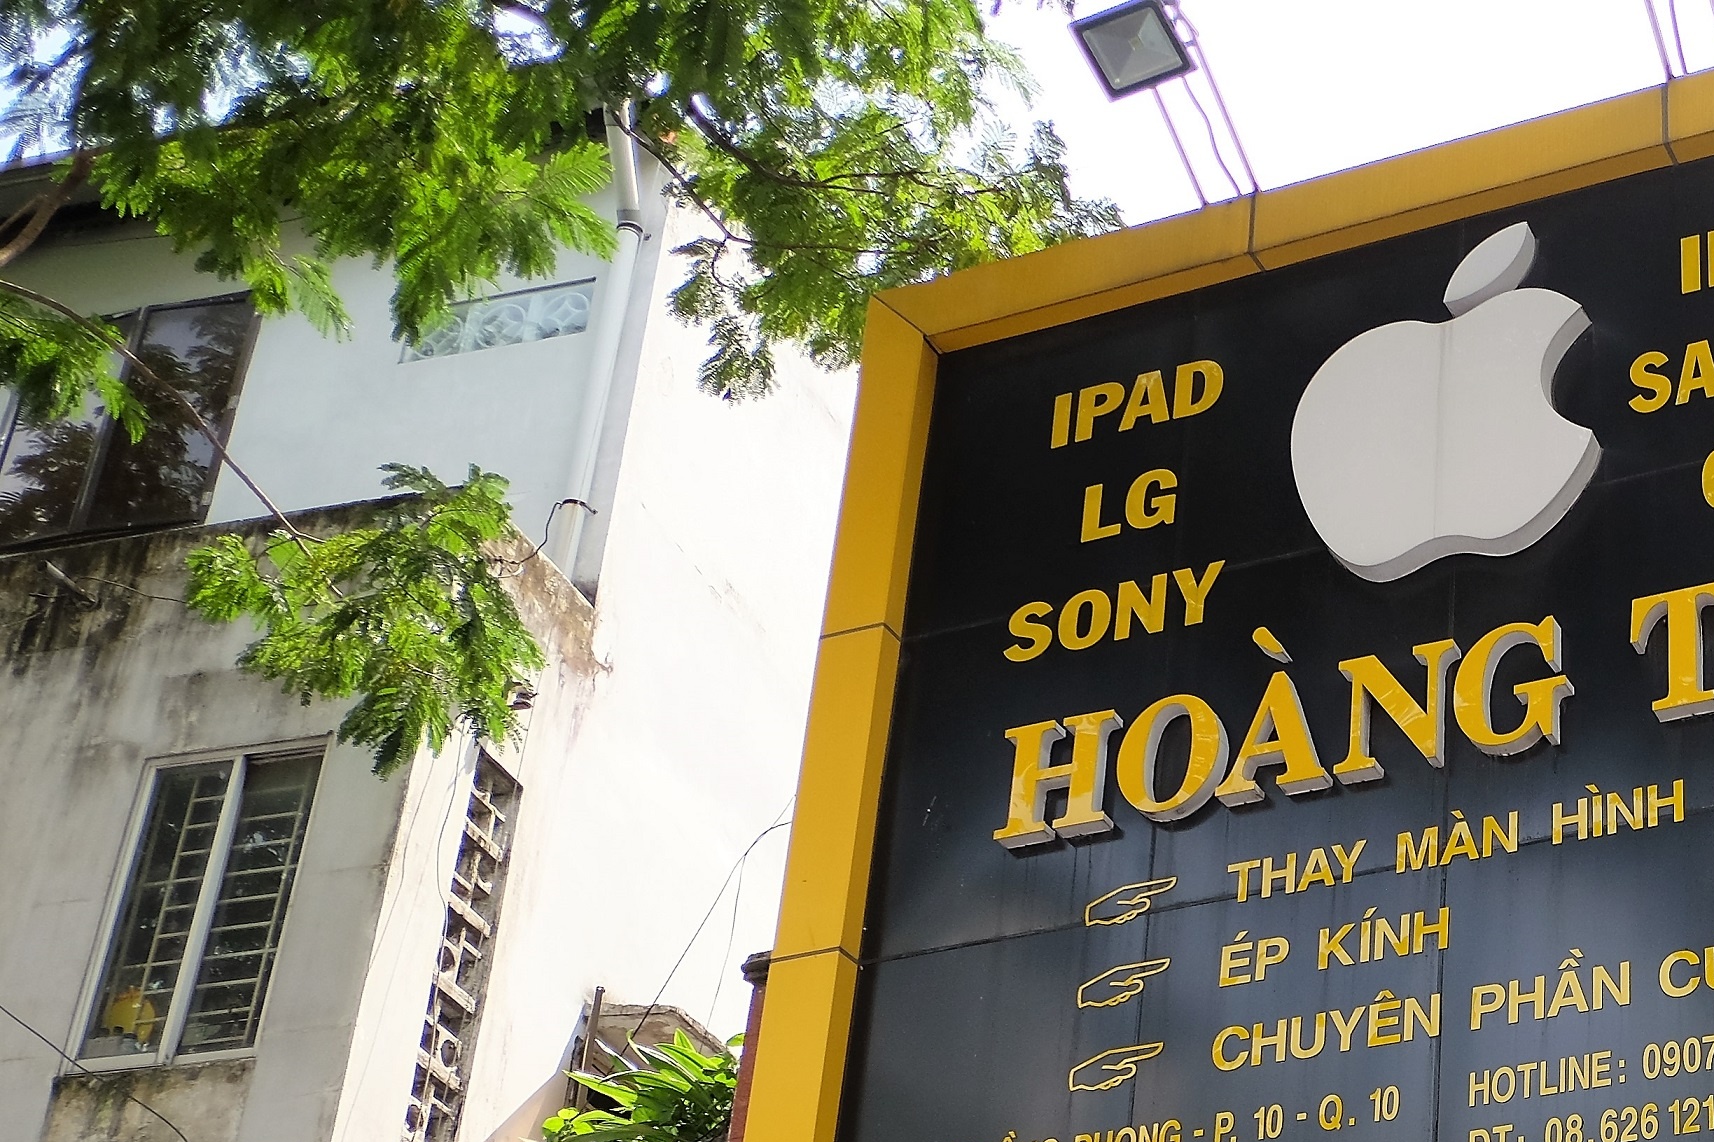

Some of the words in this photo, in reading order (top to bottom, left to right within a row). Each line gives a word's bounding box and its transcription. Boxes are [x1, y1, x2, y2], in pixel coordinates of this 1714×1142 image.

[1049, 359, 1224, 449] IPAD
[1080, 469, 1178, 543] LG
[1003, 560, 1225, 663] SONY
[992, 615, 1575, 850] HOÀNG
[1227, 840, 1367, 902] THAY
[1395, 809, 1518, 873] MÀN
[1551, 778, 1684, 846] HÌNH
[1219, 932, 1288, 988] ÉP
[1318, 906, 1450, 971] KÍNH
[1211, 989, 1441, 1071] CHUYÊN
[1469, 947, 1632, 1031] PHẦN
[1254, 1103, 1283, 1139] 10
[1370, 1085, 1400, 1122] 10
[1467, 1050, 1627, 1109] HOTLINE:
